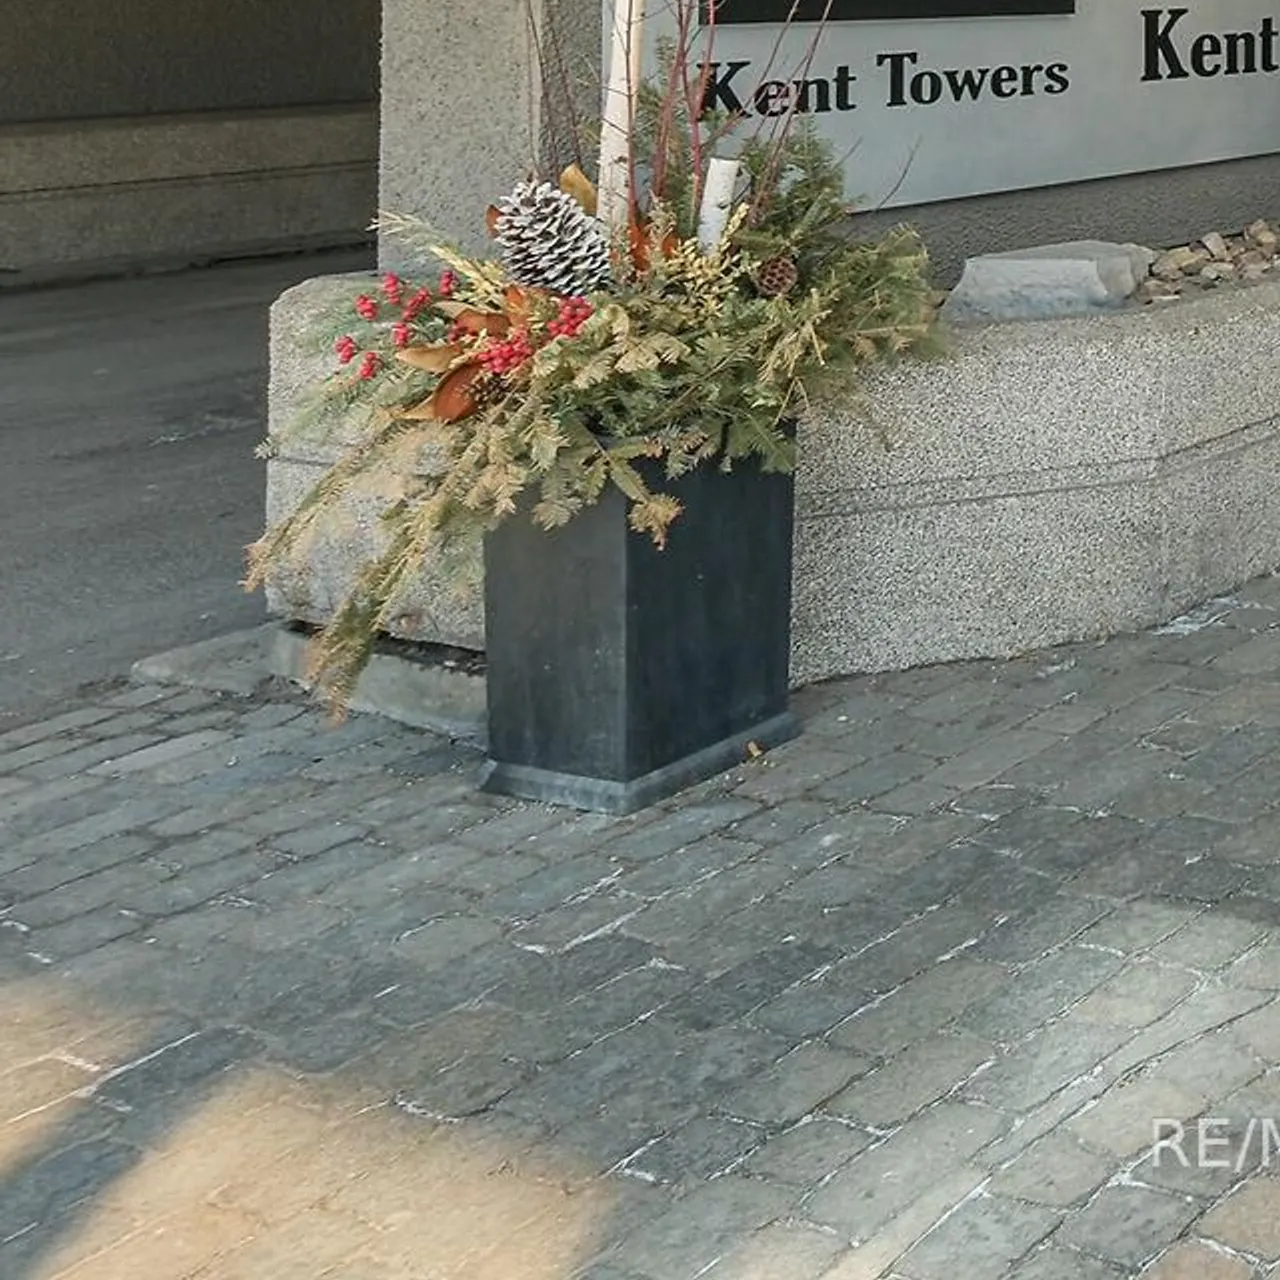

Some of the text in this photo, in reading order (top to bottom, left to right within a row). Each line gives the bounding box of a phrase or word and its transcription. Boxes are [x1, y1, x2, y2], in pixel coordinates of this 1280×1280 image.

[1140, 7, 1280, 82] Kent
[696, 51, 1070, 120] Kent Towers
